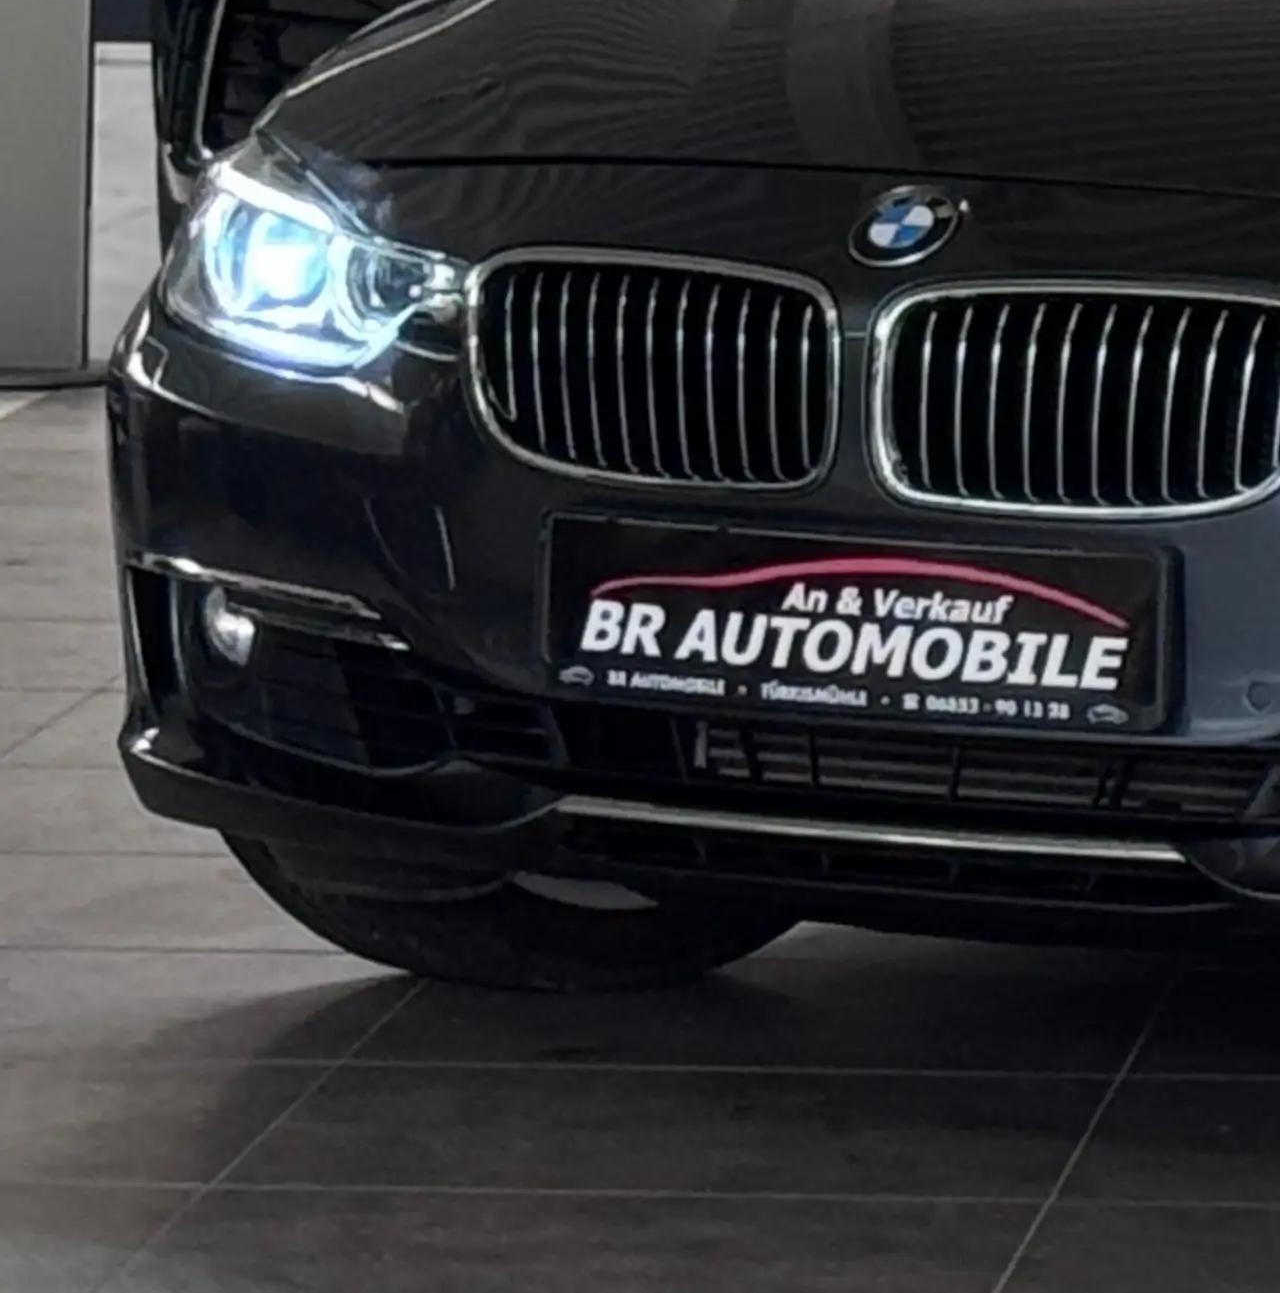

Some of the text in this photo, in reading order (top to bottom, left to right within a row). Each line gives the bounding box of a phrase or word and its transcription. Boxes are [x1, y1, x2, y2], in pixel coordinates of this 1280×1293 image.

[781, 582, 1014, 624] An & Verkauf
[580, 599, 1129, 690] BR AUTOMOBILE
